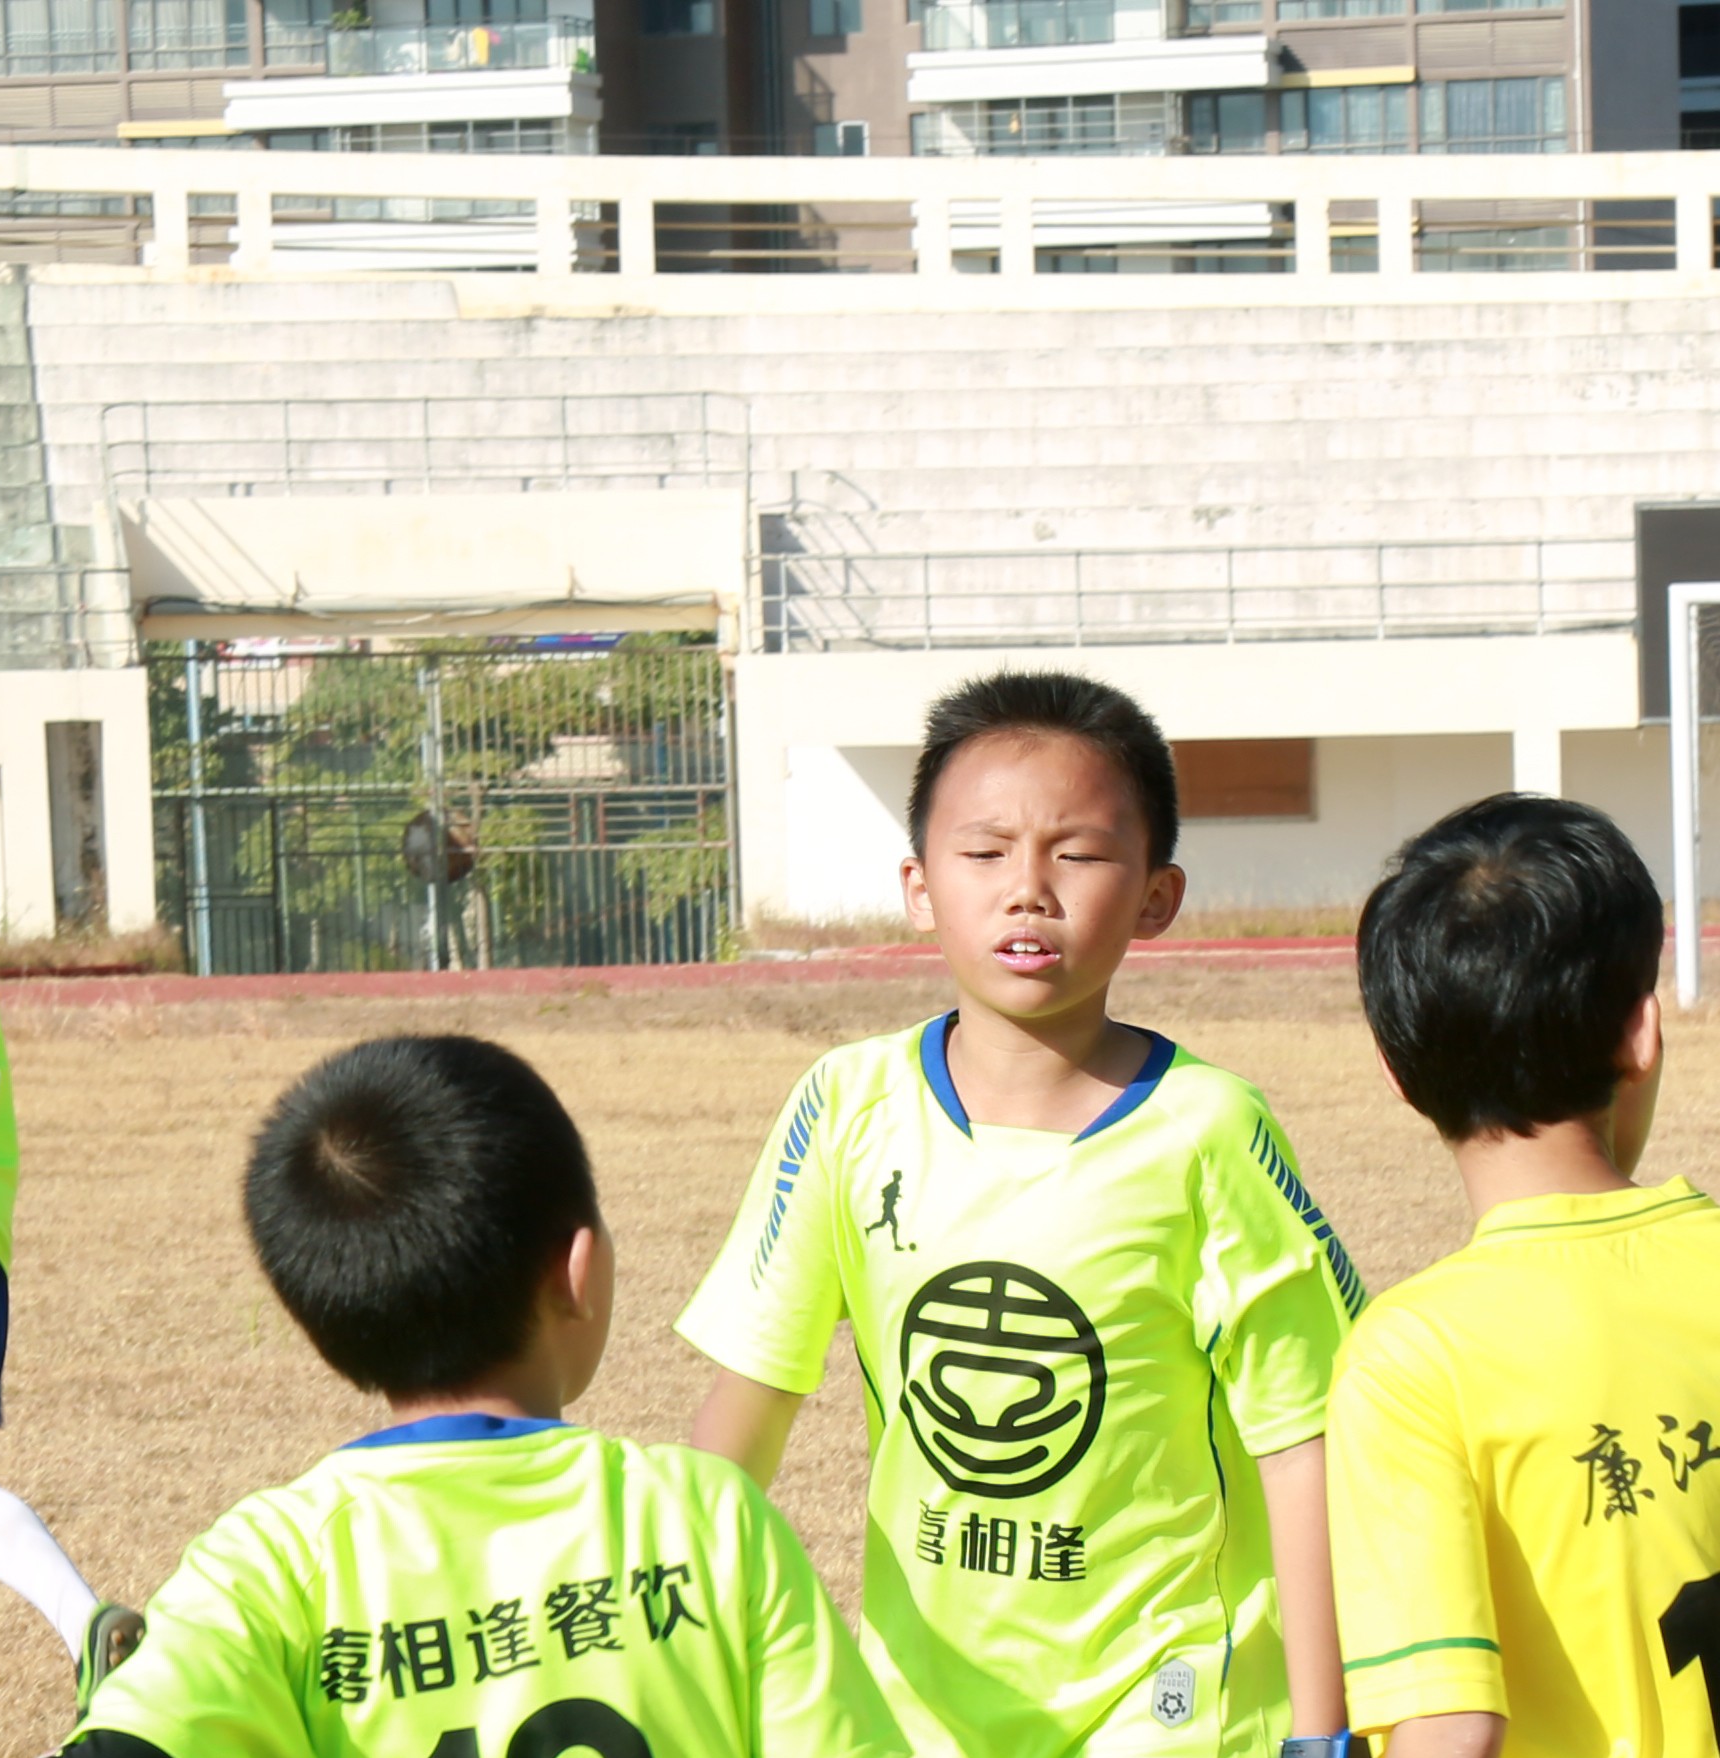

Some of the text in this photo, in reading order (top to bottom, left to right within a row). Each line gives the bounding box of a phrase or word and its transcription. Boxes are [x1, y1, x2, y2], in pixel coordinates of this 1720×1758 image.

[914, 1498, 1087, 1582] 喜相逢
[320, 1562, 707, 1704] 喜相逢餐饮
